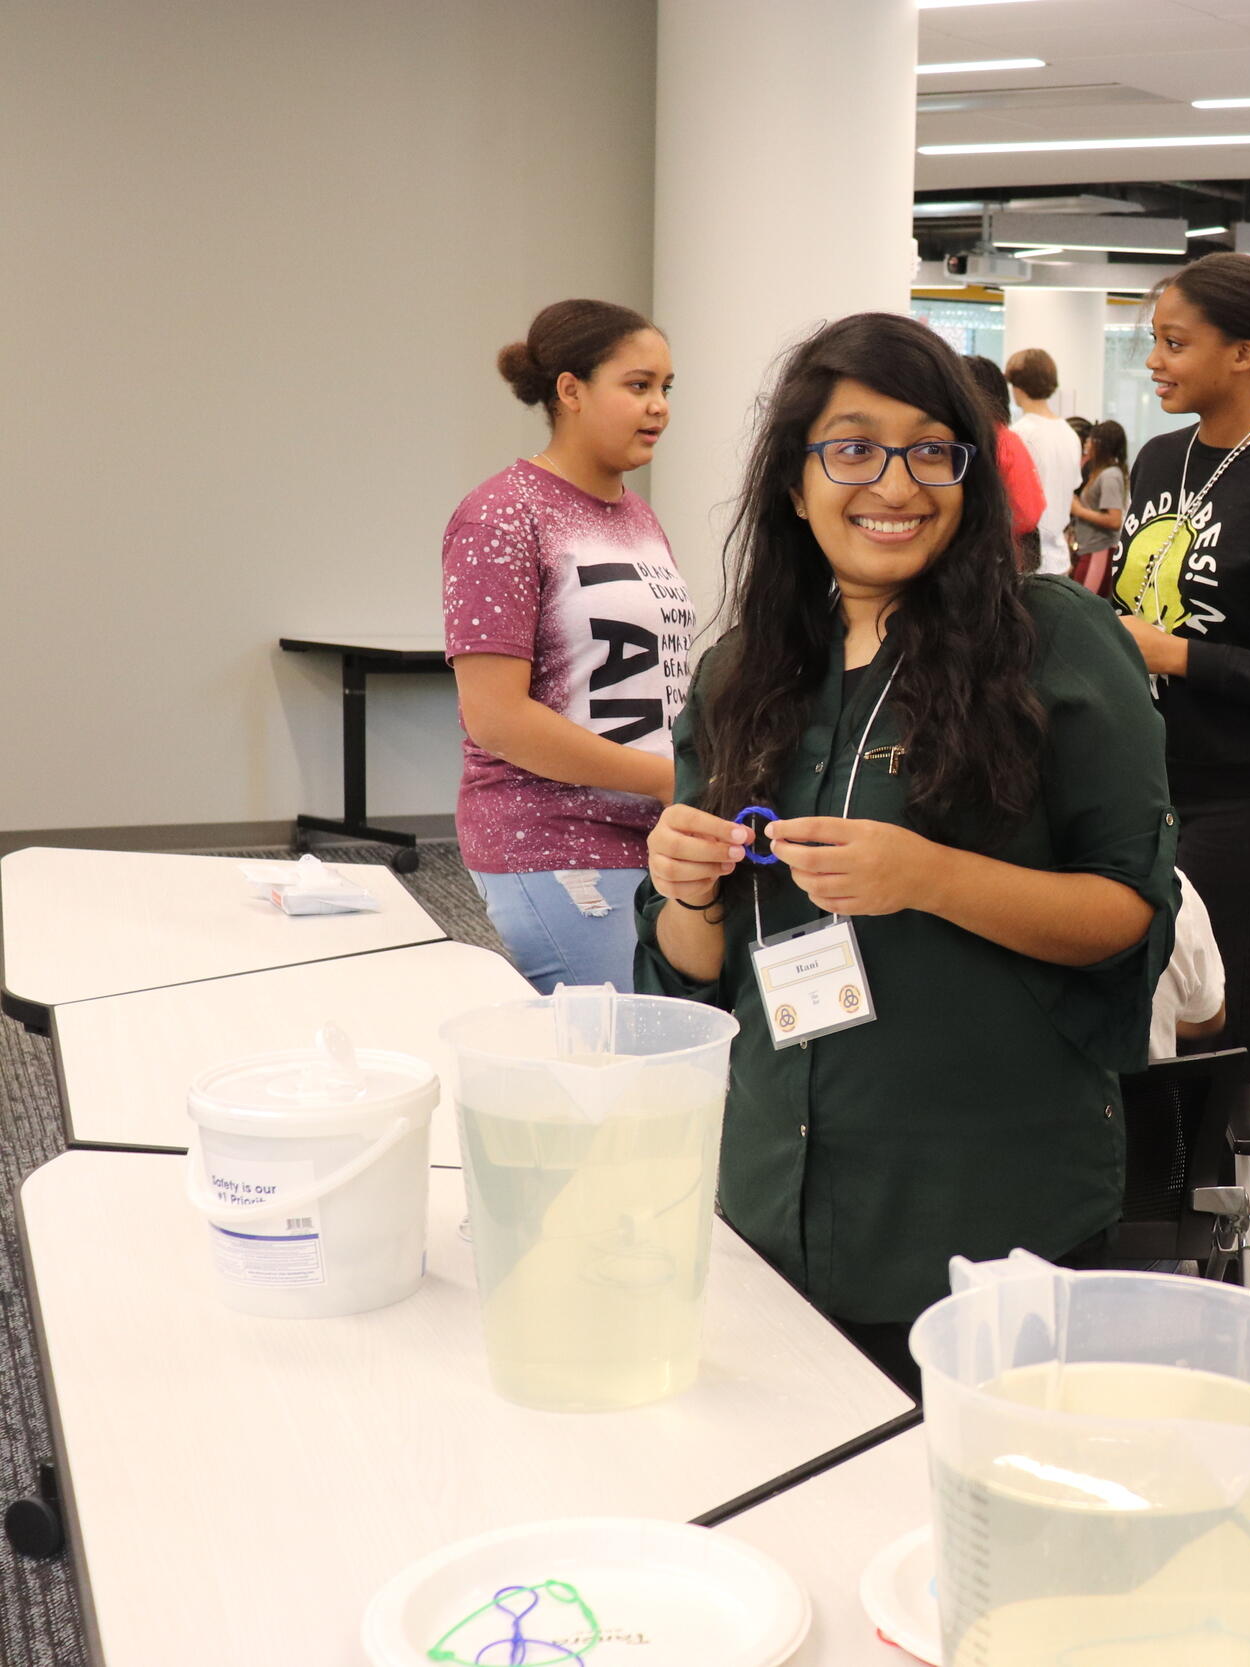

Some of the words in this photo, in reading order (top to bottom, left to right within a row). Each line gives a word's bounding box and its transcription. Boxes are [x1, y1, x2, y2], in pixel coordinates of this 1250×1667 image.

[1124, 491, 1173, 536] BAD
[577, 562, 643, 587] I
[212, 1175, 239, 1193] Safety
[242, 1183, 252, 1194] is
[255, 1184, 277, 1195] our
